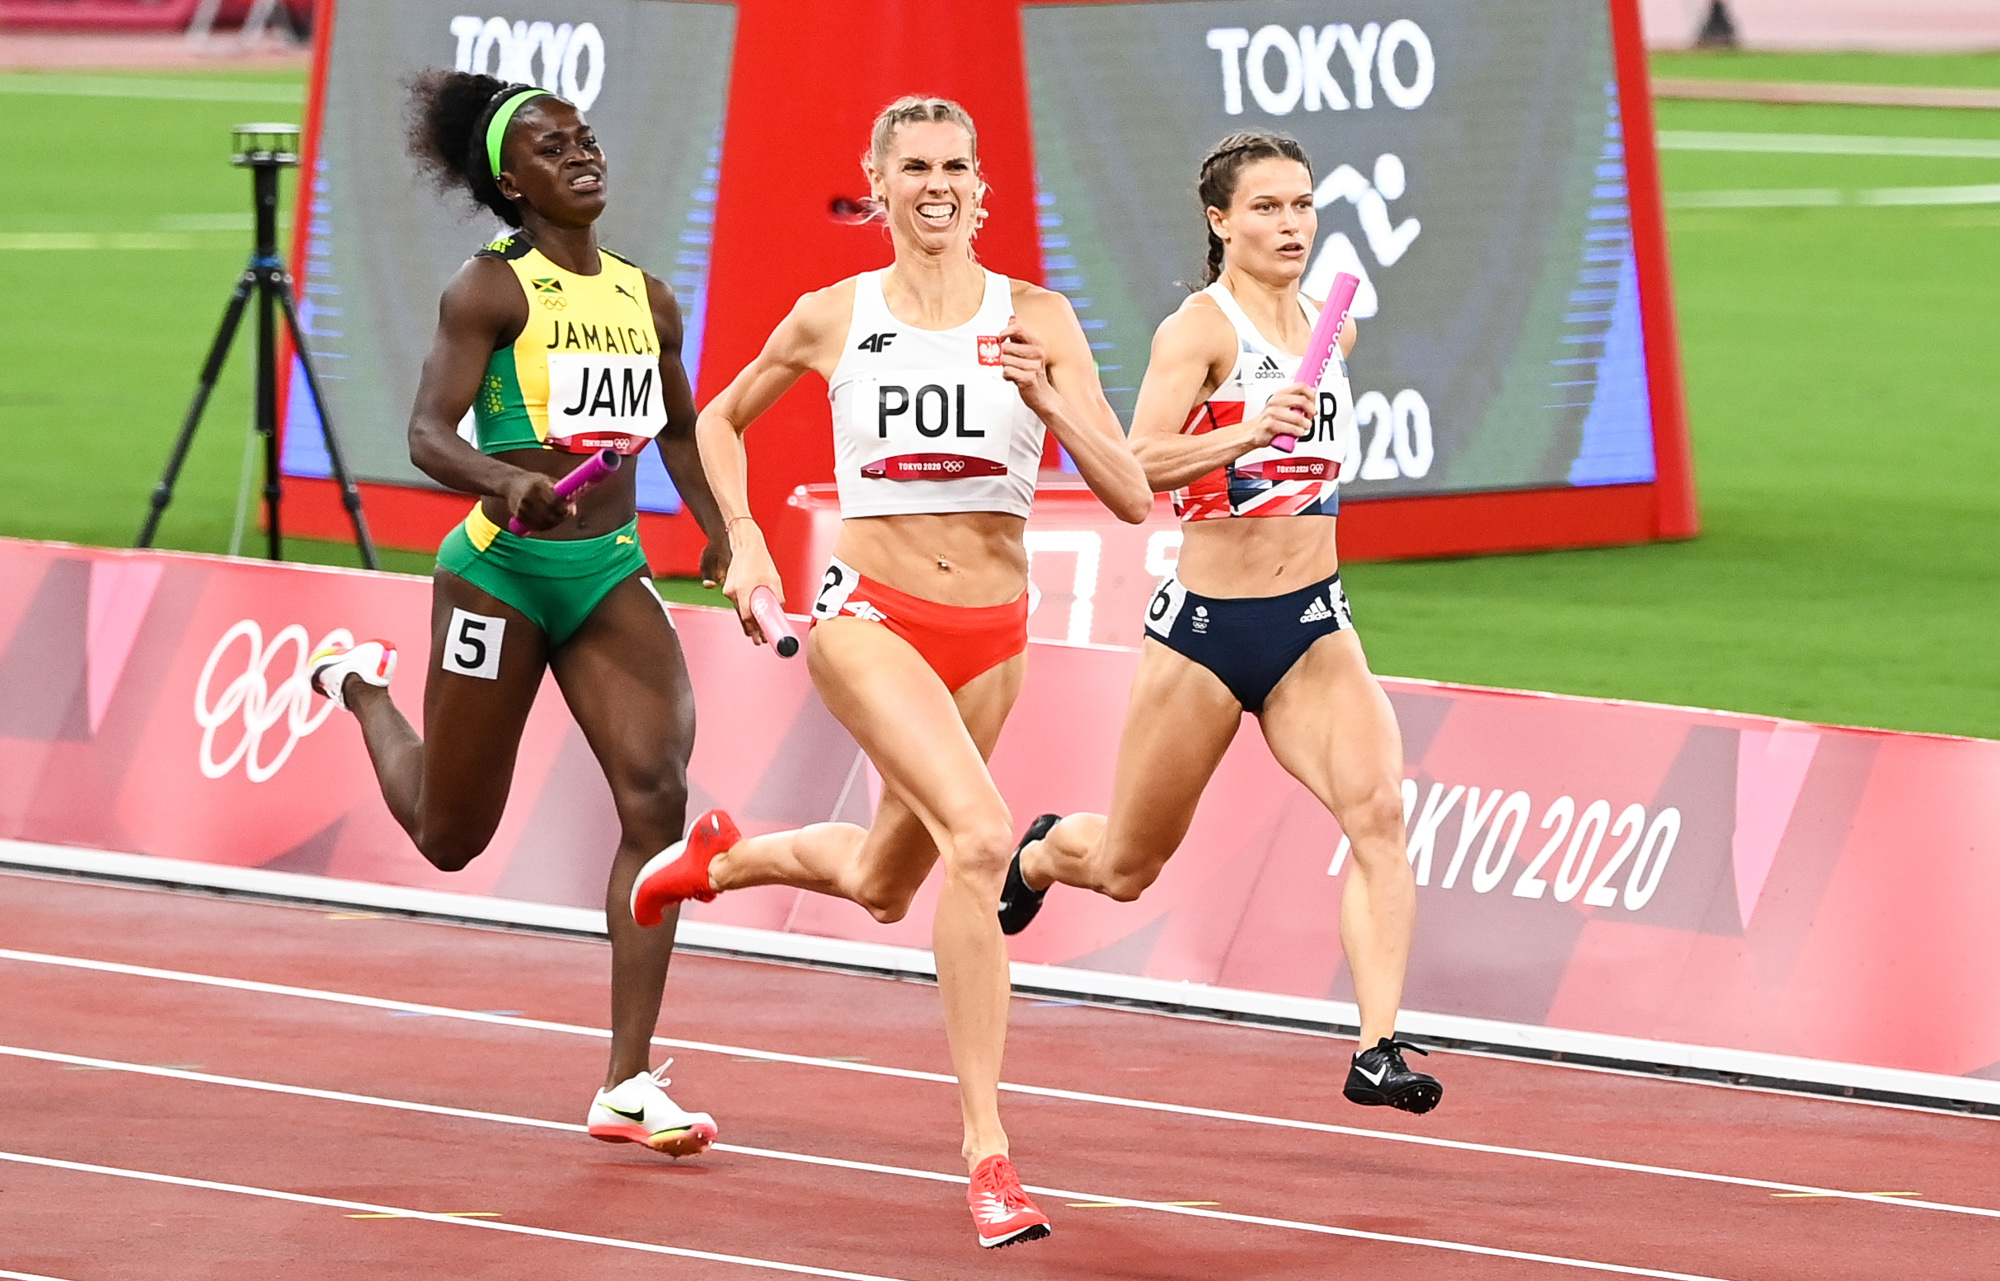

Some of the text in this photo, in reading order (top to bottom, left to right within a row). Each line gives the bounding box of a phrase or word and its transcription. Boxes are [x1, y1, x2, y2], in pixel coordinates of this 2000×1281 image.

[450, 16, 604, 112] TOKYO
[1206, 19, 1435, 115] TOKYO
[546, 320, 655, 356] JAMAICA
[563, 367, 652, 417] JAM
[1255, 370, 1285, 379] adidas
[879, 384, 985, 438] POL
[898, 462, 942, 471] TOKYO 2020
[1276, 465, 1295, 473] TOKYO
[816, 565, 843, 613] 2
[1150, 578, 1174, 621] 6
[1300, 609, 1332, 624] adidas
[454, 618, 487, 670] 5
[1327, 778, 1682, 911] KYO 2020
